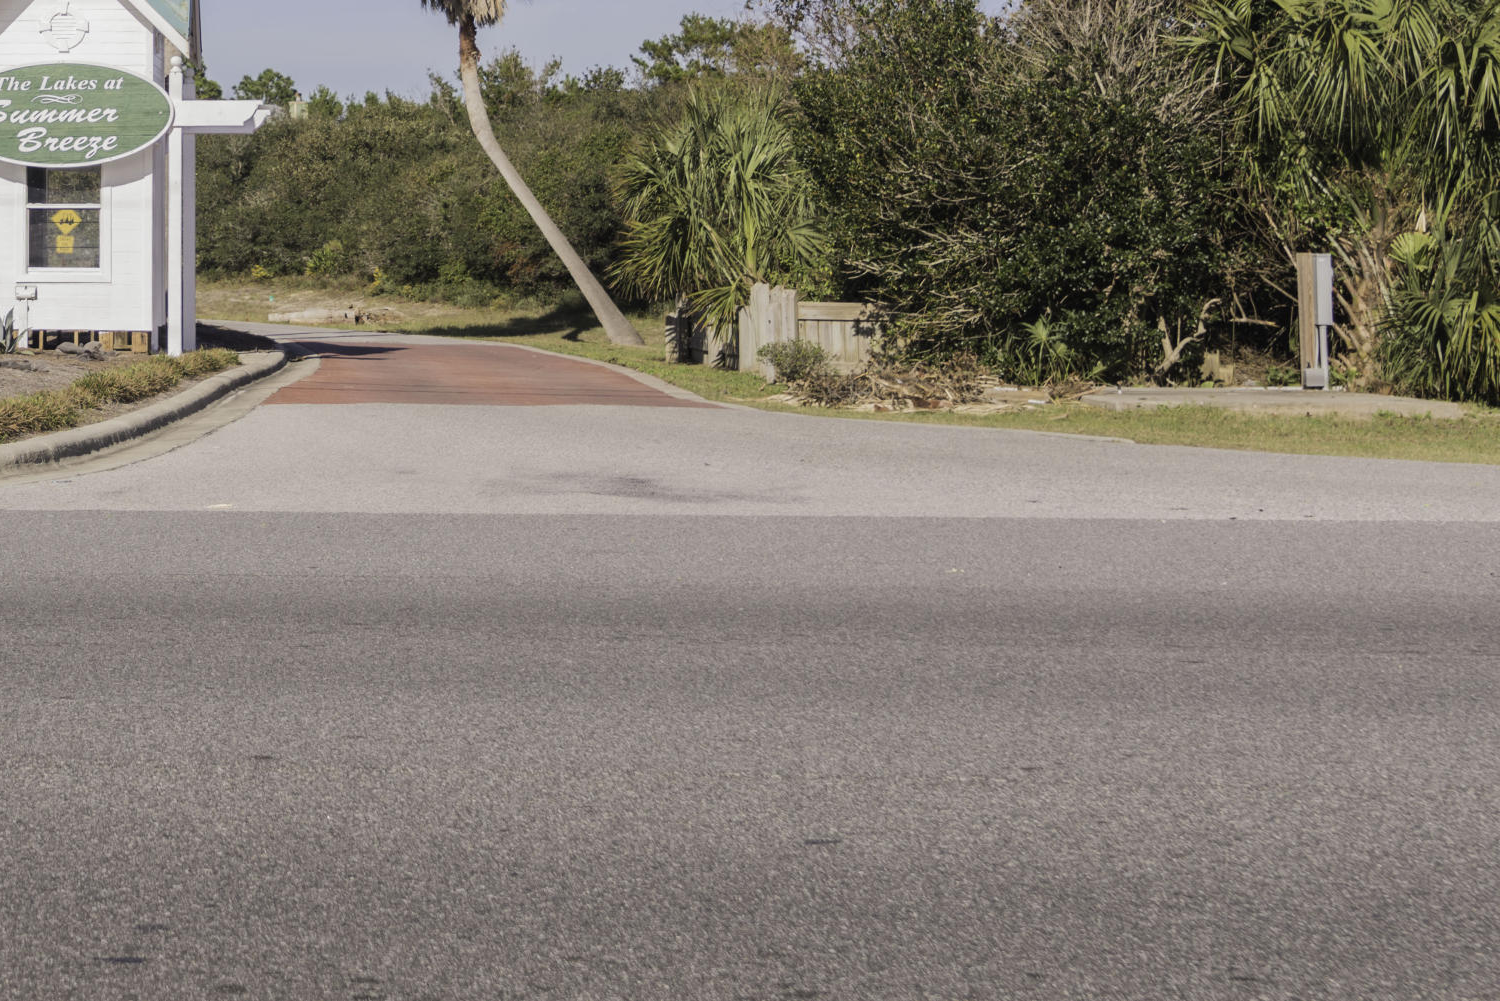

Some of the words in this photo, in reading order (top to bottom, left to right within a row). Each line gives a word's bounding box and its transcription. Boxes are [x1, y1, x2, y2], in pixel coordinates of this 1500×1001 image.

[39, 75, 98, 91] Lakes
[103, 76, 124, 90] at
[16, 127, 118, 159] Breeze
